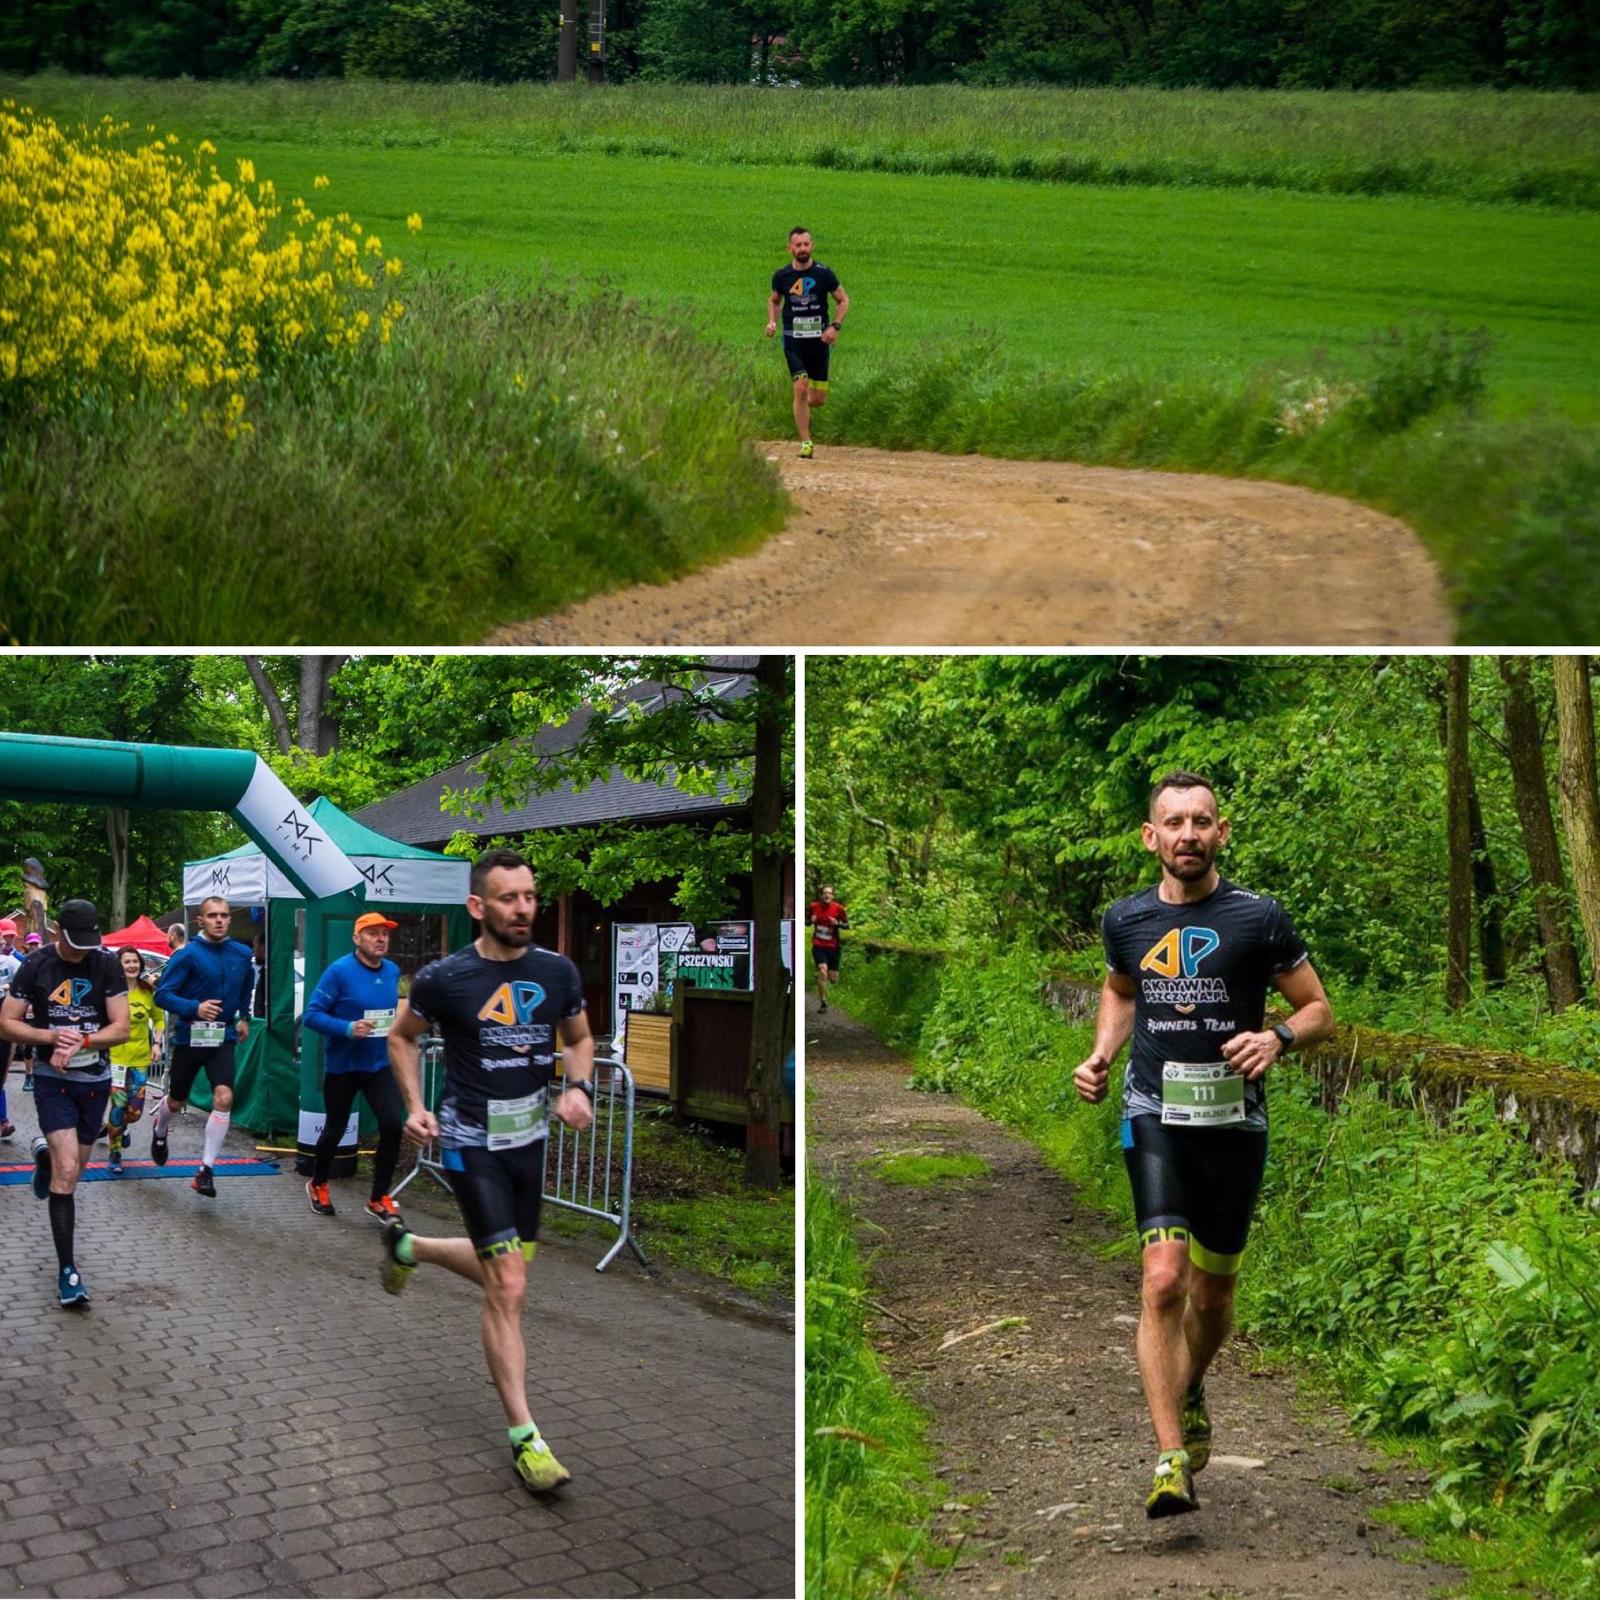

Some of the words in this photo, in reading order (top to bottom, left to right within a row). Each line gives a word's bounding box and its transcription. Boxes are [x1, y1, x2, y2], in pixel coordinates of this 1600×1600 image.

[275, 824, 310, 863] TIME
[1140, 926, 1220, 978] AP
[1142, 978, 1226, 993] AKTYWNA
[477, 980, 547, 1026] AP
[1203, 1018, 1235, 1031] TEAM
[1191, 1086, 1215, 1101] 111
